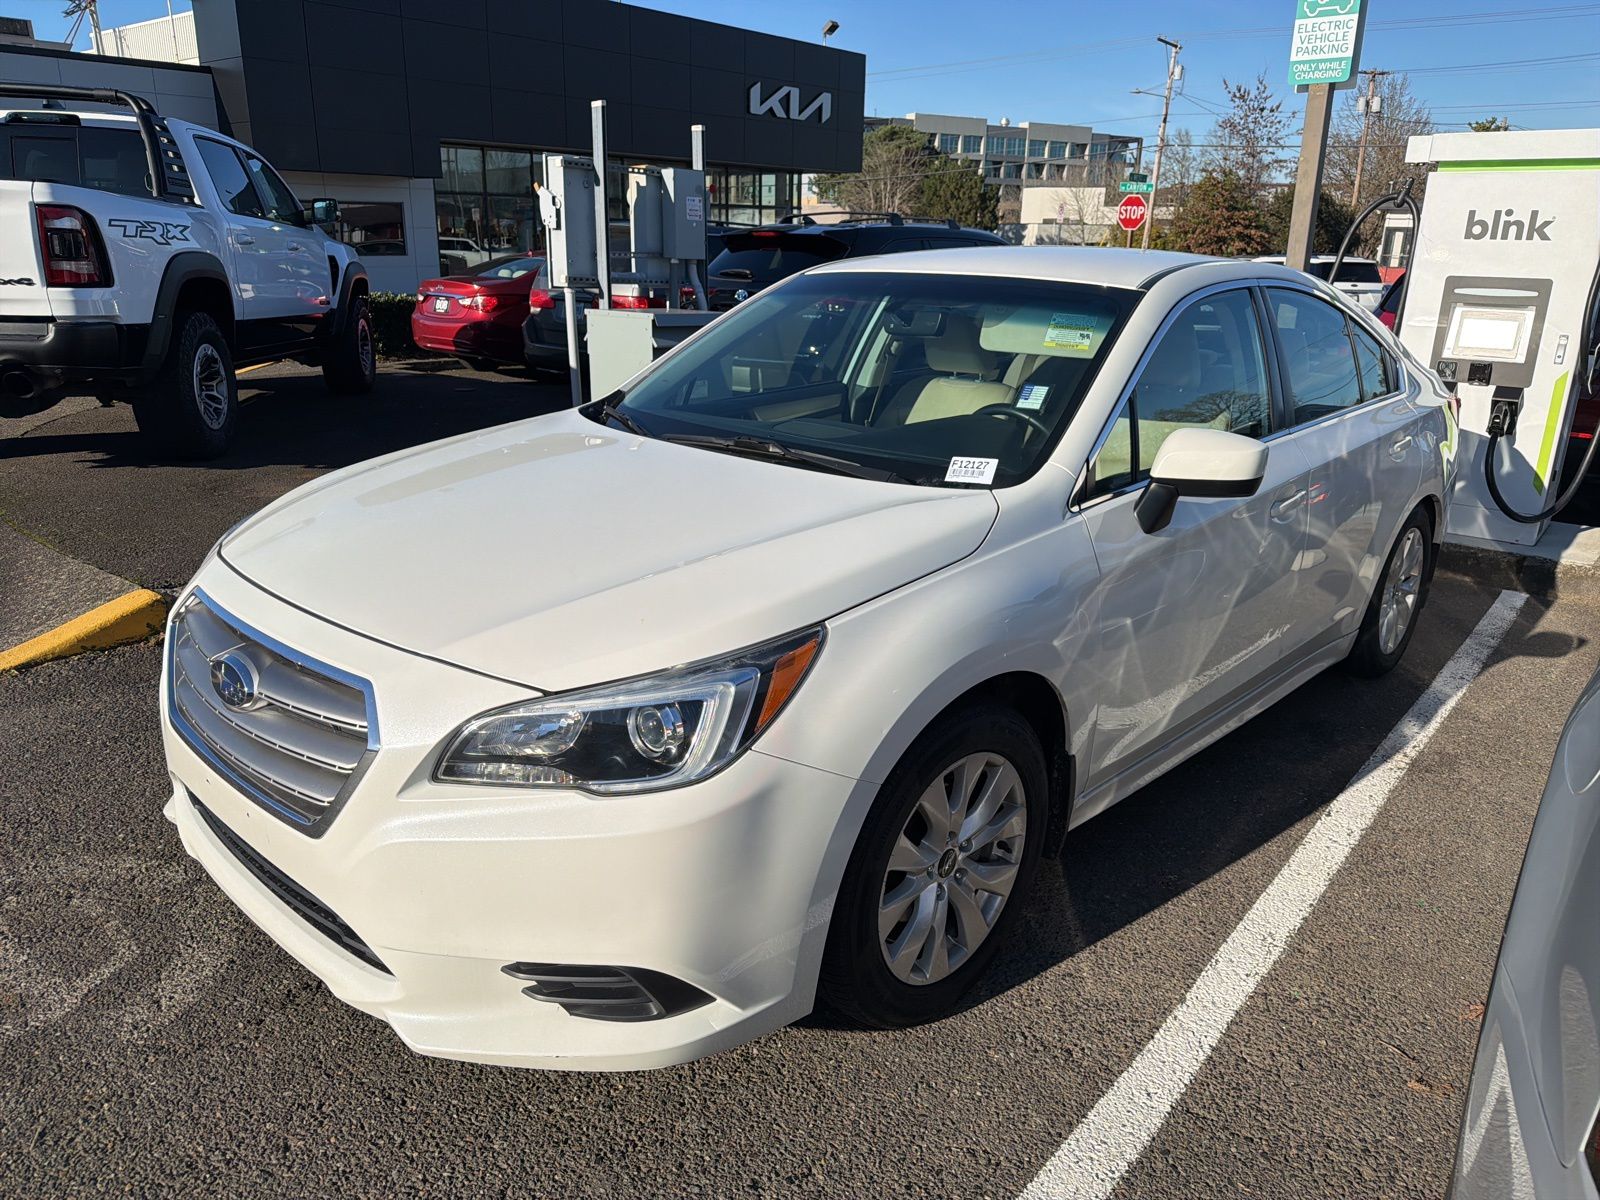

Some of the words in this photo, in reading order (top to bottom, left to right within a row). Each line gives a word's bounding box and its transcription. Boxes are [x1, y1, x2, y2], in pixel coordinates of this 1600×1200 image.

[1298, 19, 1354, 34] ELECTRIC
[1299, 31, 1349, 45] VEHICLE
[1296, 43, 1349, 56] PARKING
[1293, 62, 1317, 72] ONLY
[1318, 61, 1347, 70] WHILE
[1295, 69, 1342, 80] CHARGING
[750, 81, 831, 124] KIA
[1119, 205, 1145, 219] STOP
[1464, 208, 1554, 241] blink
[108, 218, 191, 246] TRX
[951, 459, 990, 470] F12127
